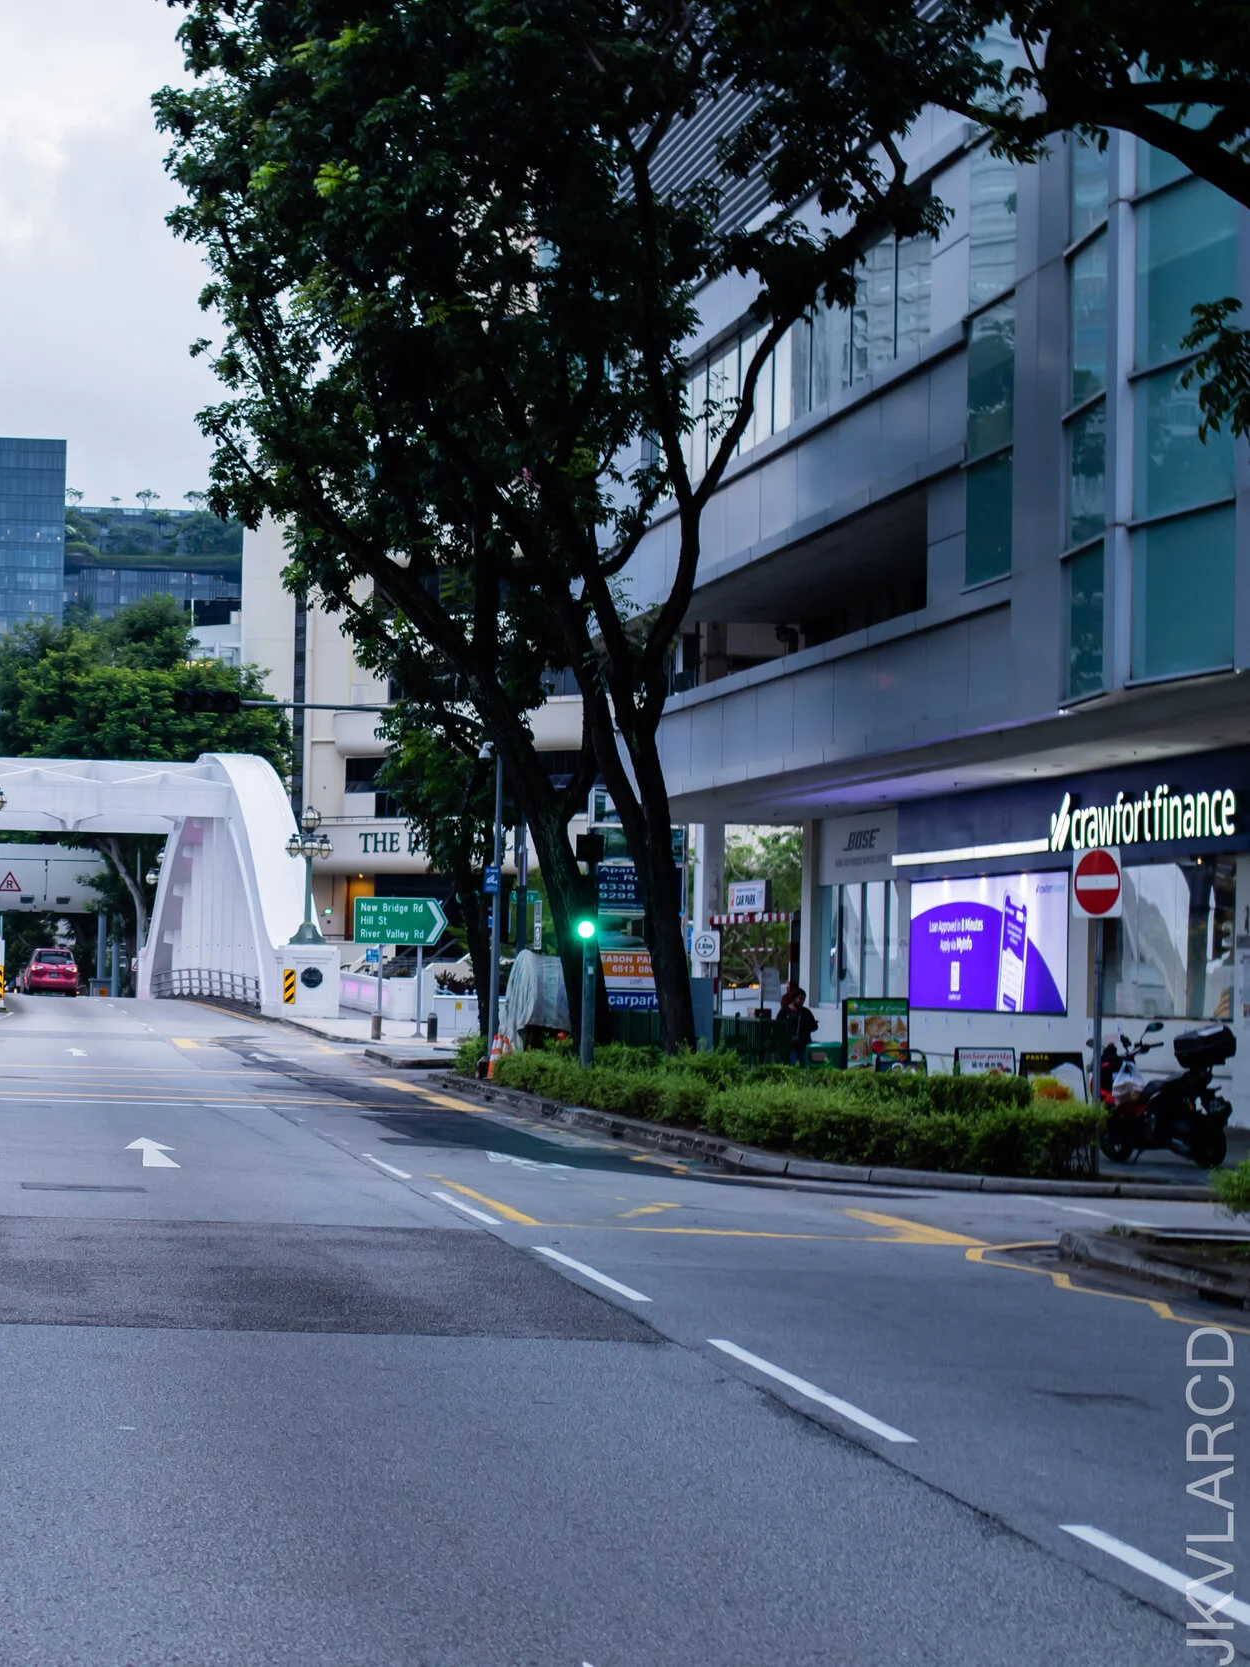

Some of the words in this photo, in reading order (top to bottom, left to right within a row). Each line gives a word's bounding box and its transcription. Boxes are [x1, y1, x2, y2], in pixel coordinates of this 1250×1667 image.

[359, 832, 400, 853] THE
[842, 828, 881, 852] BOSE
[599, 866, 636, 874] Apart
[599, 883, 636, 891] 6338
[736, 895, 744, 906] CAR
[745, 894, 756, 905] PARK
[360, 903, 378, 912] New
[382, 903, 409, 914] Bridge
[413, 903, 424, 912] Rd
[360, 916, 374, 925] Hill
[378, 916, 387, 925] St
[939, 920, 956, 935] Approved
[965, 917, 984, 931] Minutes
[360, 929, 380, 938] River
[386, 929, 409, 940] Valley
[414, 929, 424, 939] Rd
[600, 954, 633, 963] EASON
[612, 964, 635, 973] 6513
[608, 994, 658, 1007] carpark
